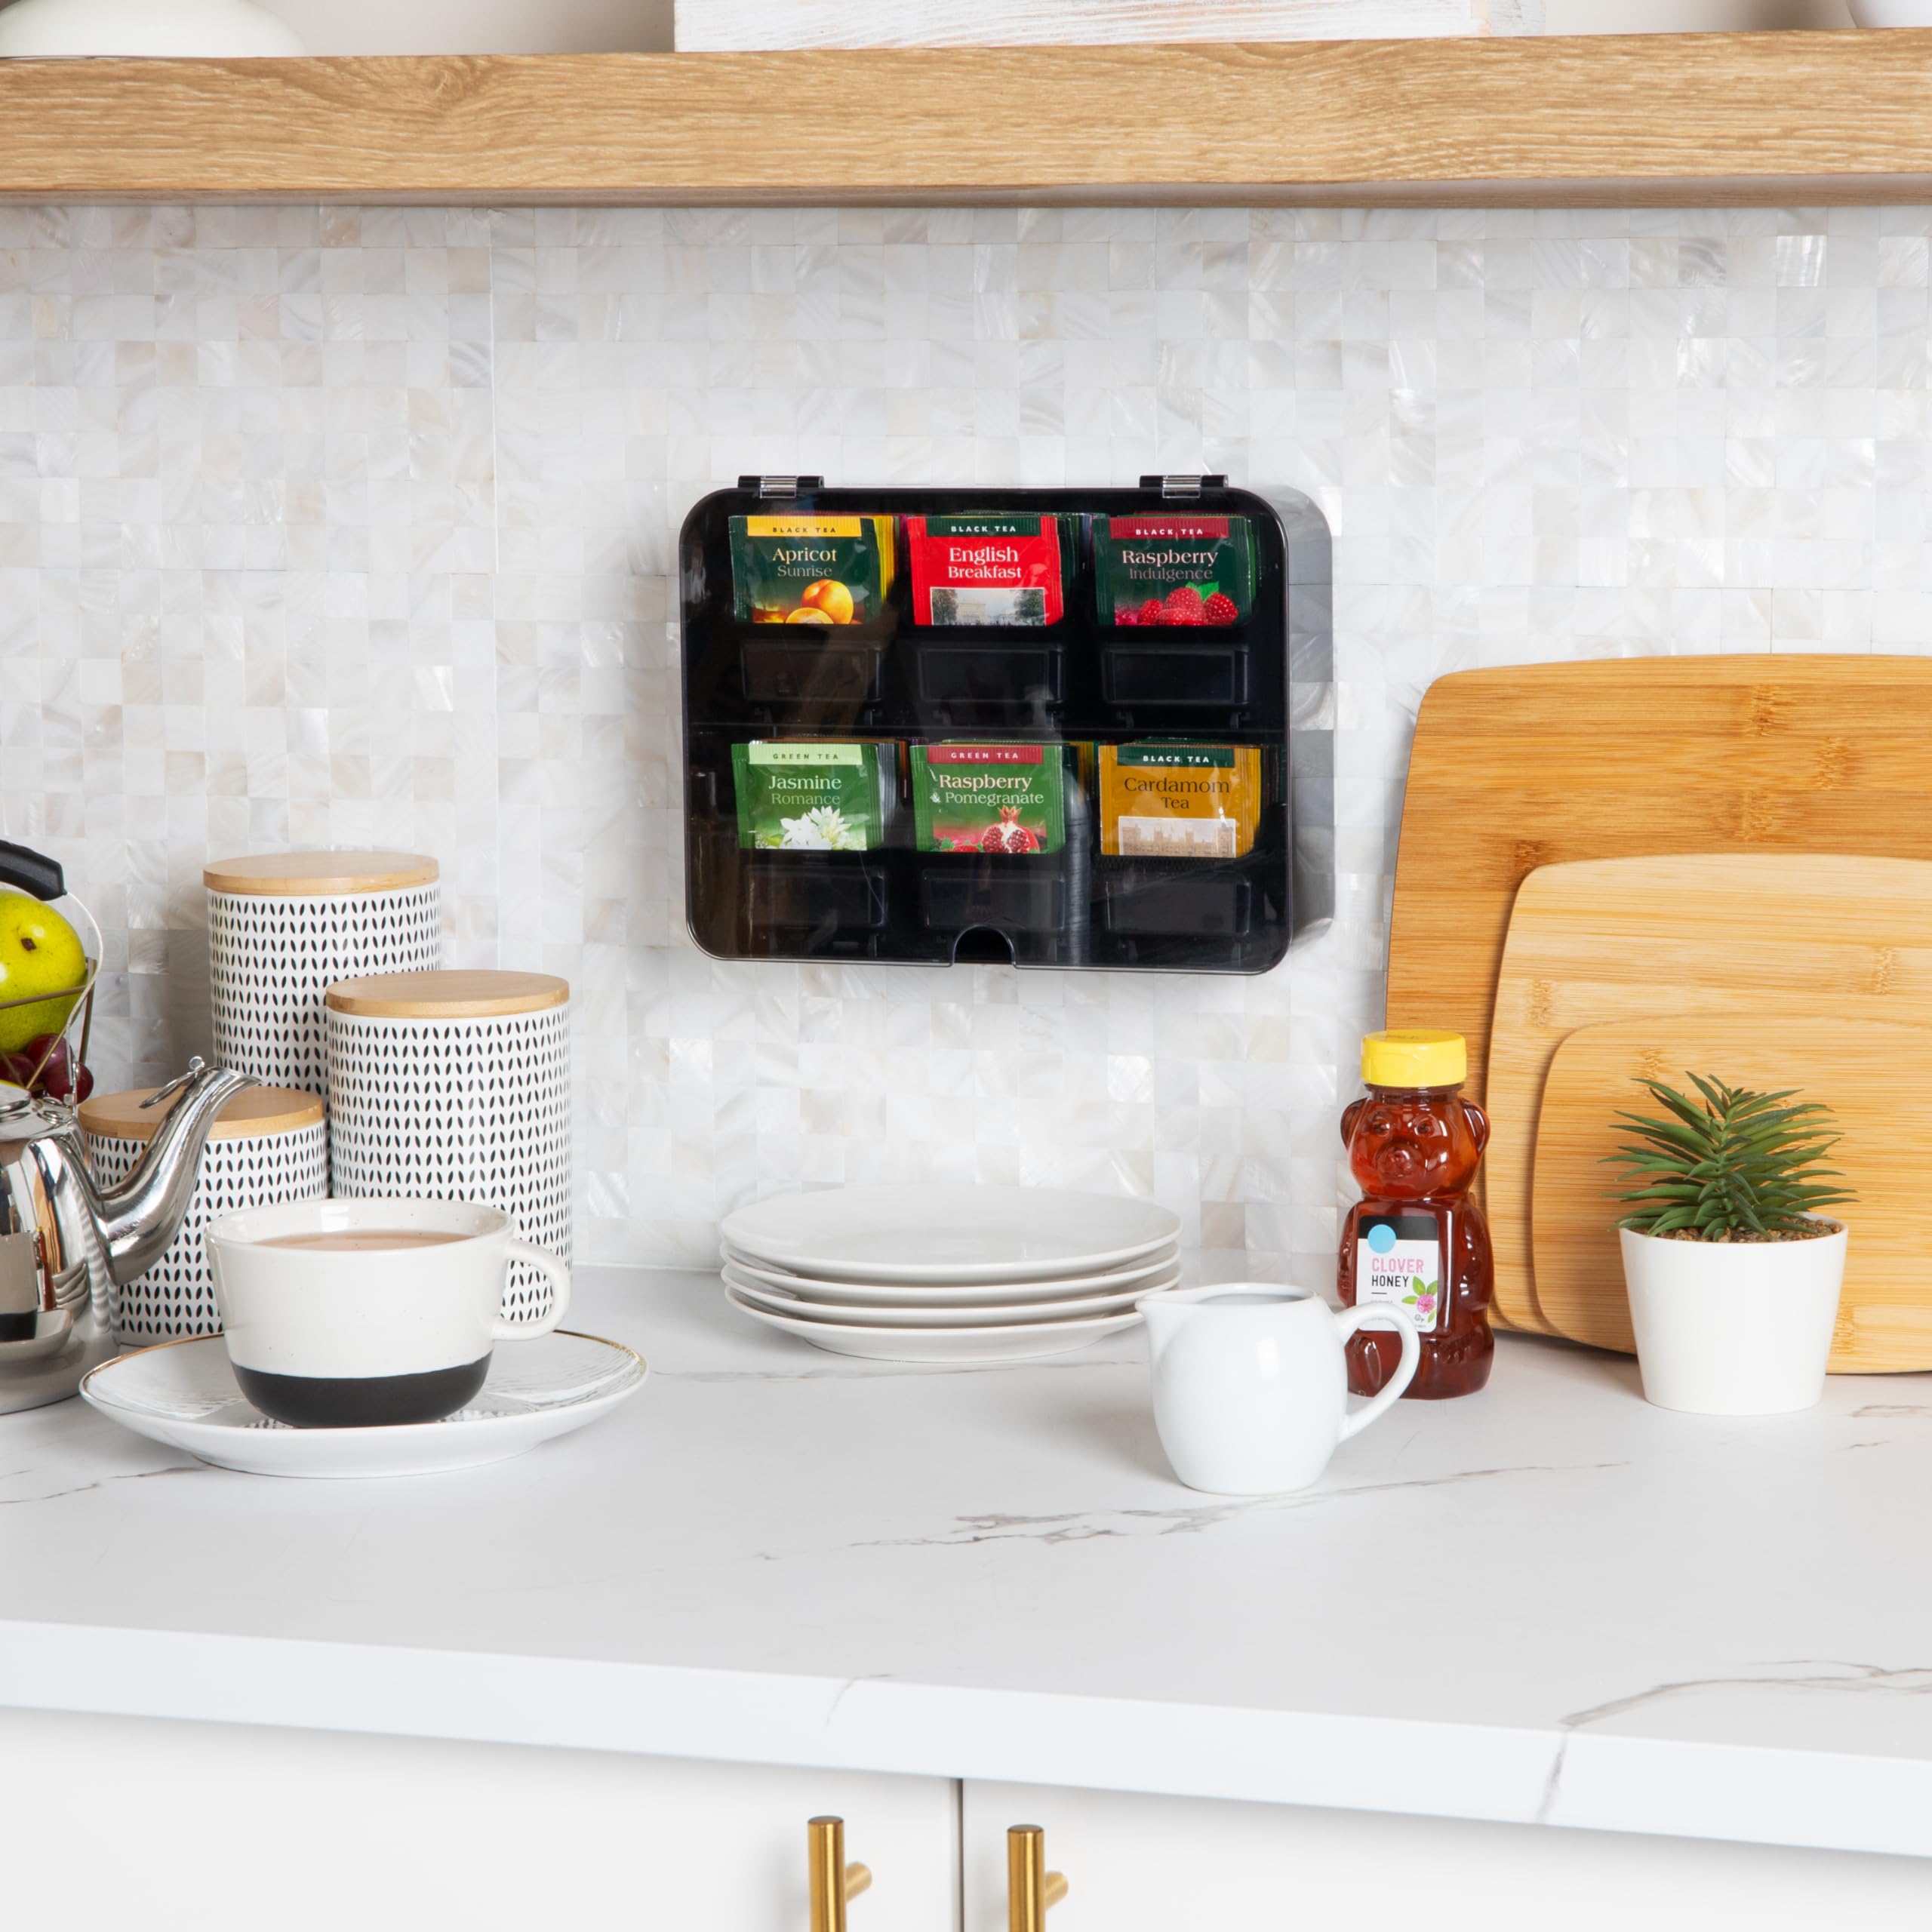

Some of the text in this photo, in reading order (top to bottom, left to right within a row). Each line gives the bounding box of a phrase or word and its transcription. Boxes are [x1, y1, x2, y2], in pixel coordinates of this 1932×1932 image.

[772, 547, 838, 564] Apricot
[949, 546, 1019, 565] English
[1122, 549, 1219, 568] Raspberry
[777, 565, 832, 578] Sunrise
[948, 565, 1022, 579] Breakfast
[1129, 568, 1213, 583] Indulgence
[768, 775, 841, 790] Jasmine
[940, 774, 1032, 792] Raspberry
[1124, 777, 1230, 793] Cardamom
[771, 792, 841, 805] Romance
[930, 792, 1044, 808] & Pomegranate
[1161, 796, 1190, 809] Tea
[1371, 1257, 1425, 1273] CLOVER
[1371, 1275, 1409, 1287] HONEY
